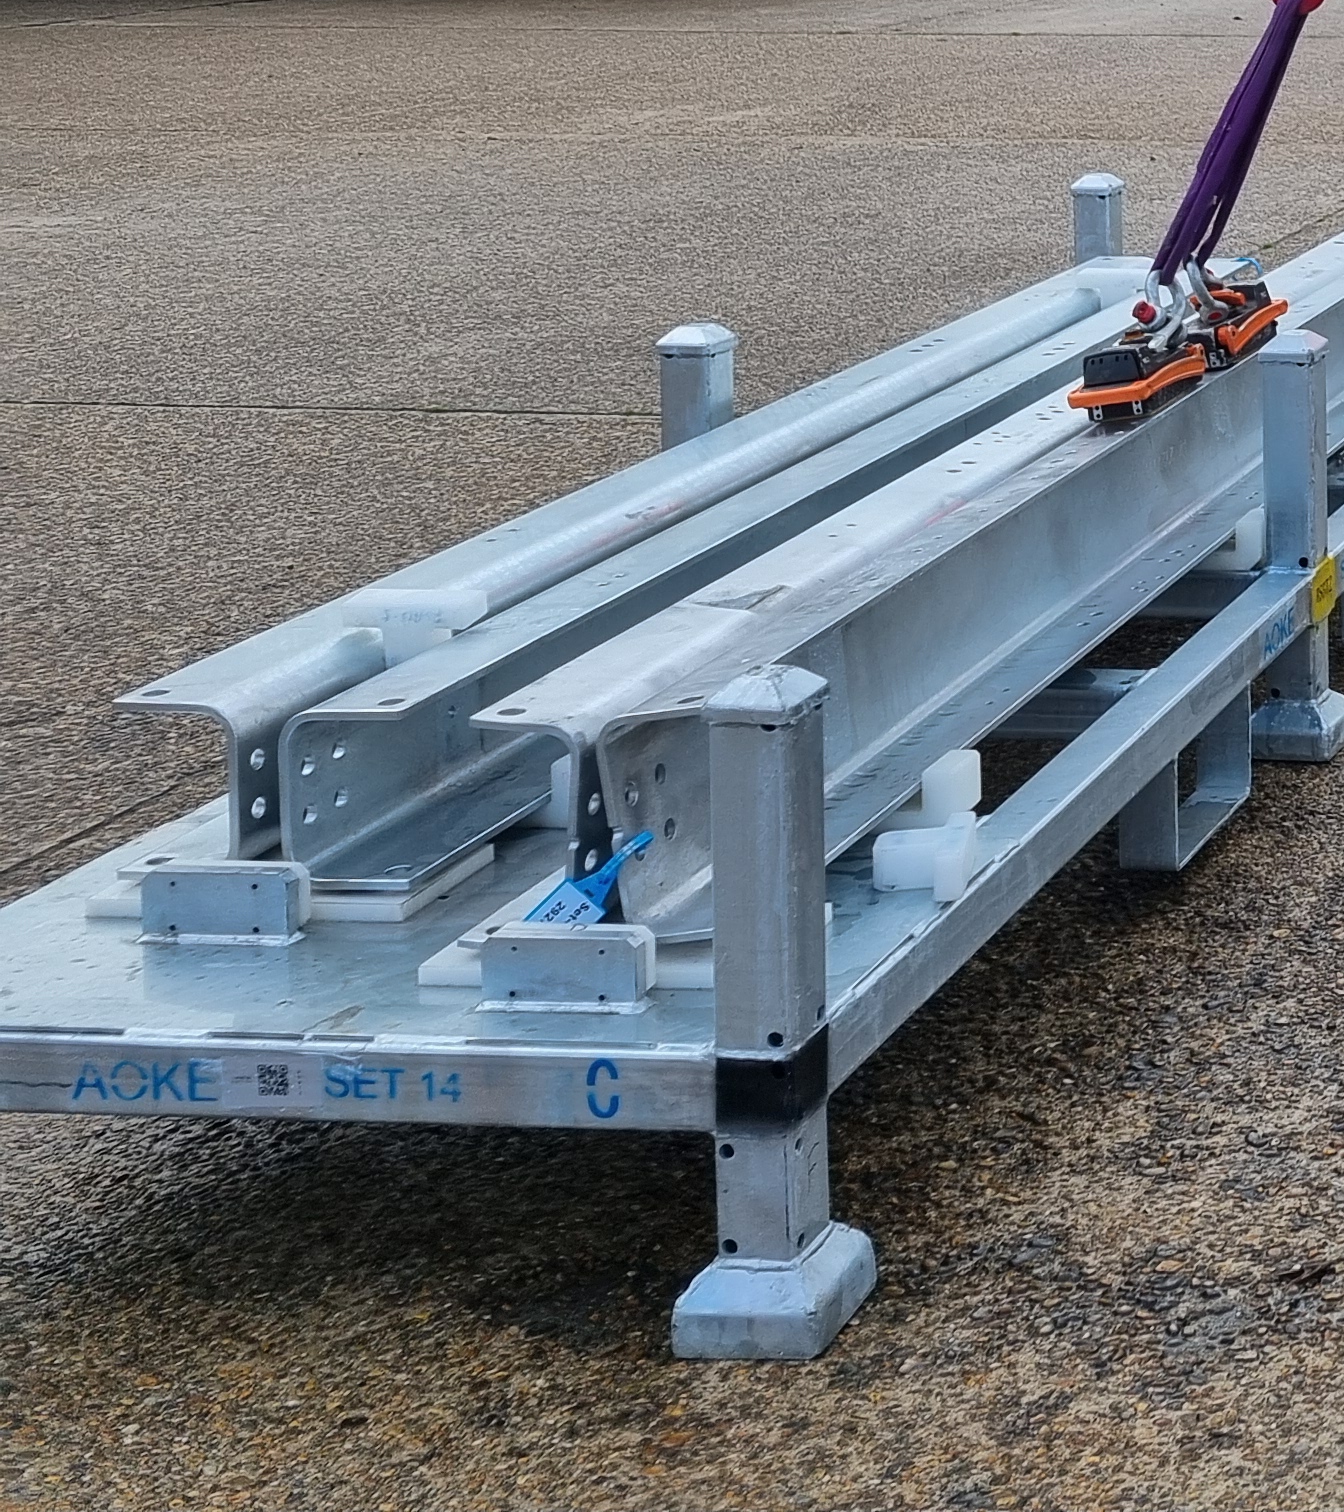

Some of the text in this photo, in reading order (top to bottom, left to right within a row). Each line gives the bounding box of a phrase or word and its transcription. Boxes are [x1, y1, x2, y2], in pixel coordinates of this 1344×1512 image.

[72, 1060, 218, 1101] AOKE
[324, 1067, 405, 1099] SET
[421, 1070, 462, 1103] 14
